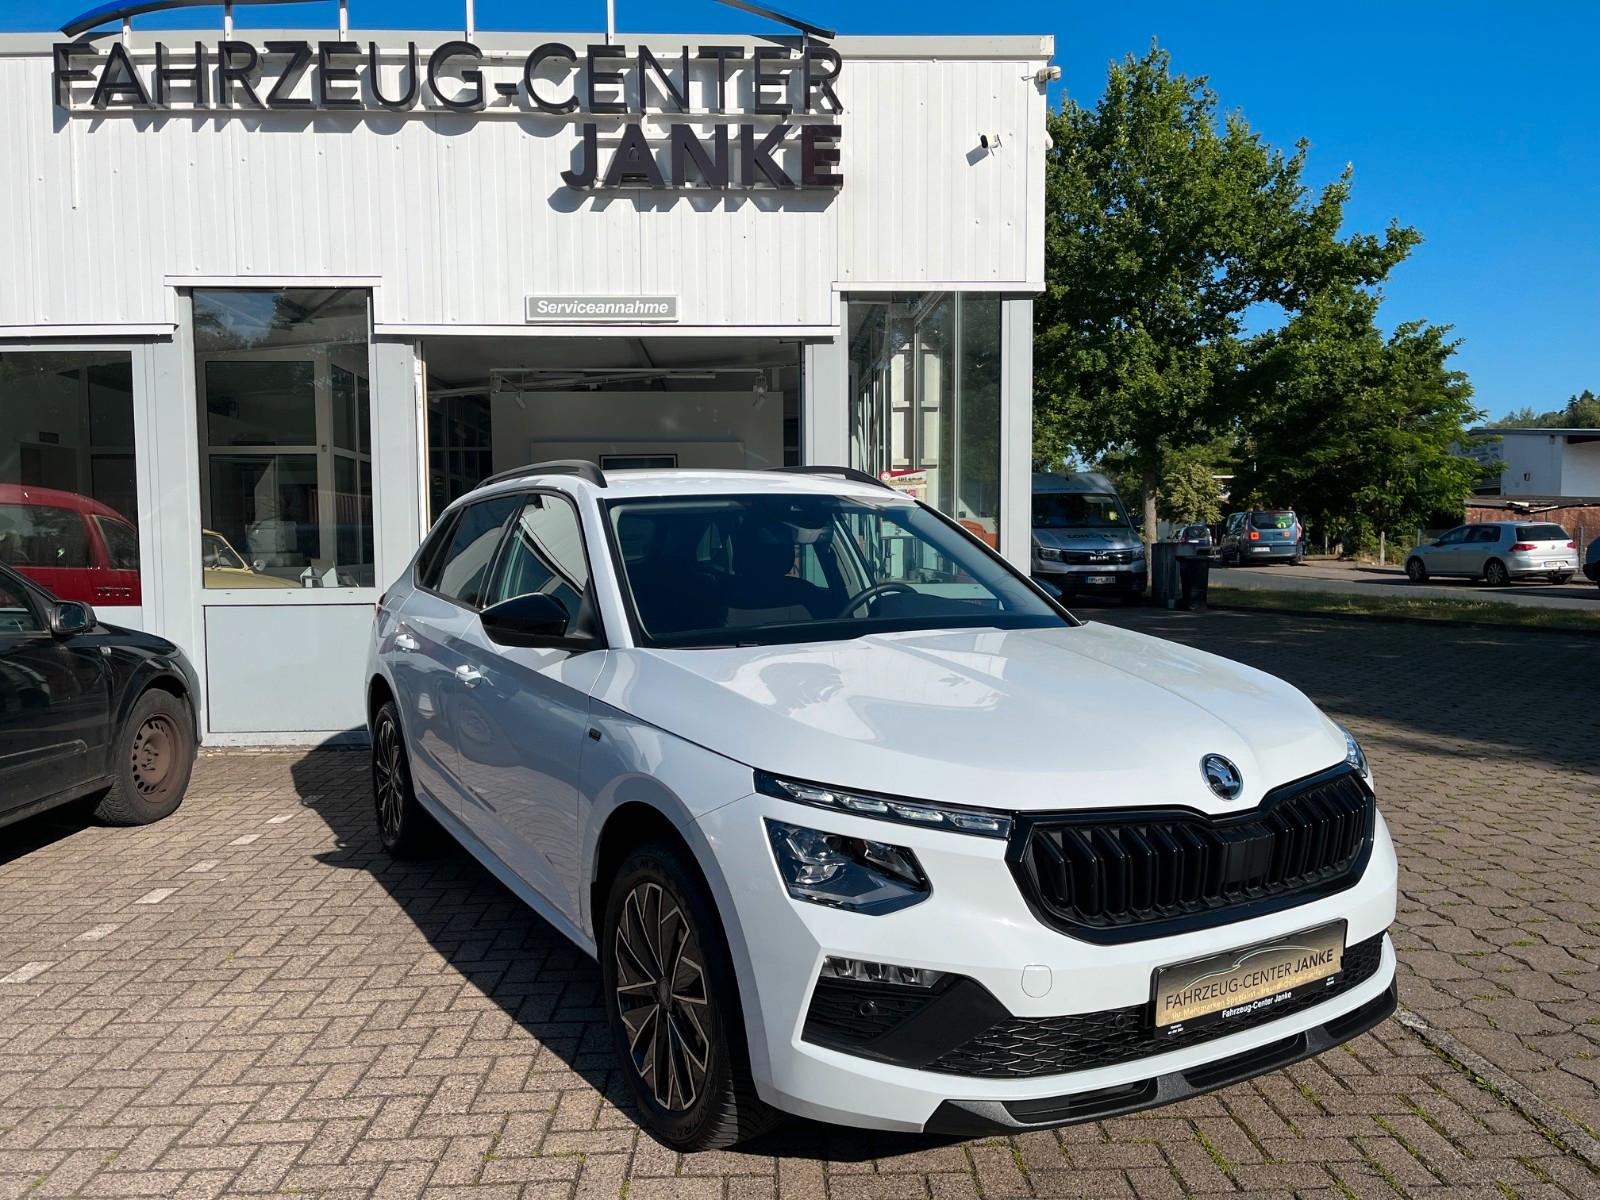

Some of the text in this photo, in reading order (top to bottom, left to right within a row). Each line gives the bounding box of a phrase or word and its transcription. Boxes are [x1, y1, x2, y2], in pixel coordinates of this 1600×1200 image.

[53, 41, 843, 115] FAHRZEUG-CENTER
[560, 123, 844, 191] JANKE
[536, 300, 669, 314] Serviceannahme
[1165, 962, 1292, 1010] FAHRZEUG-CENTER
[1294, 948, 1334, 973] JANKE
[1221, 991, 1292, 1019] Fahrzeug-Center Janke
